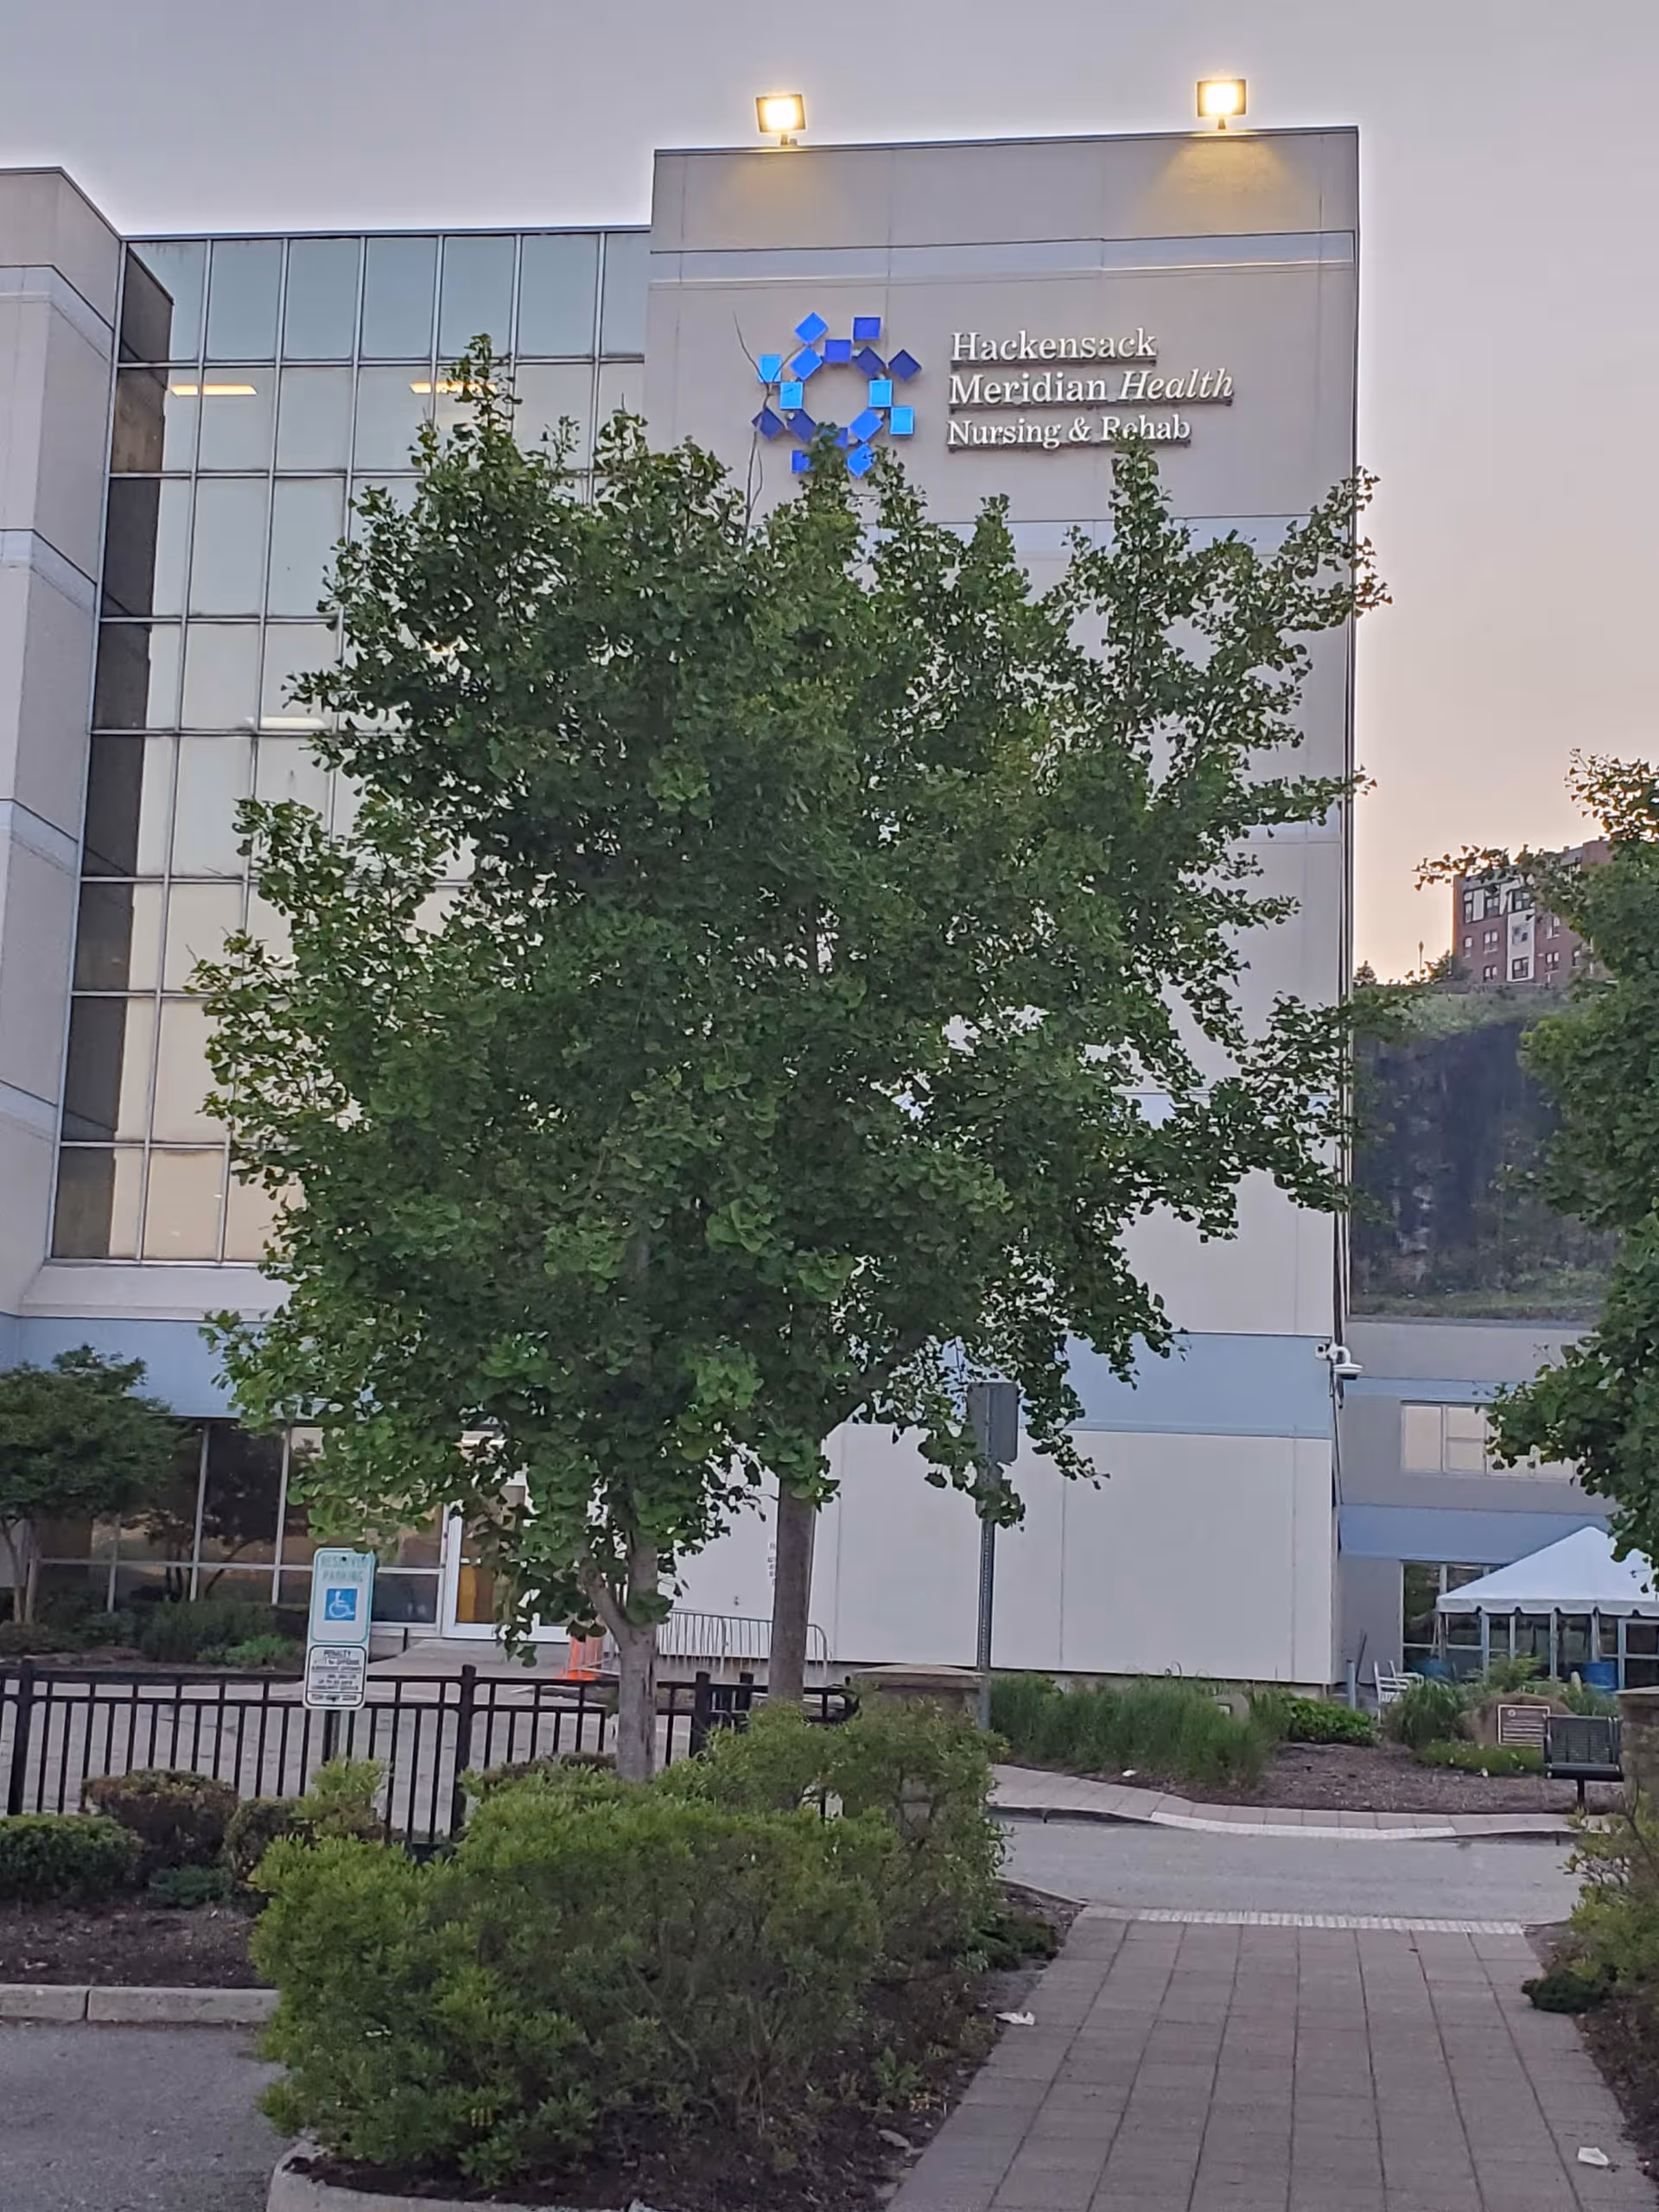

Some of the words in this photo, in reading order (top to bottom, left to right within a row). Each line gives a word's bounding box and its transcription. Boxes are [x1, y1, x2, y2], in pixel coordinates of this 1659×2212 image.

[950, 327, 1157, 362] Hackensack
[948, 372, 1107, 404] Meridian
[1117, 367, 1234, 400] Health
[947, 418, 1062, 448] Nursing
[1068, 416, 1090, 442] &
[1101, 413, 1191, 442] Rehab
